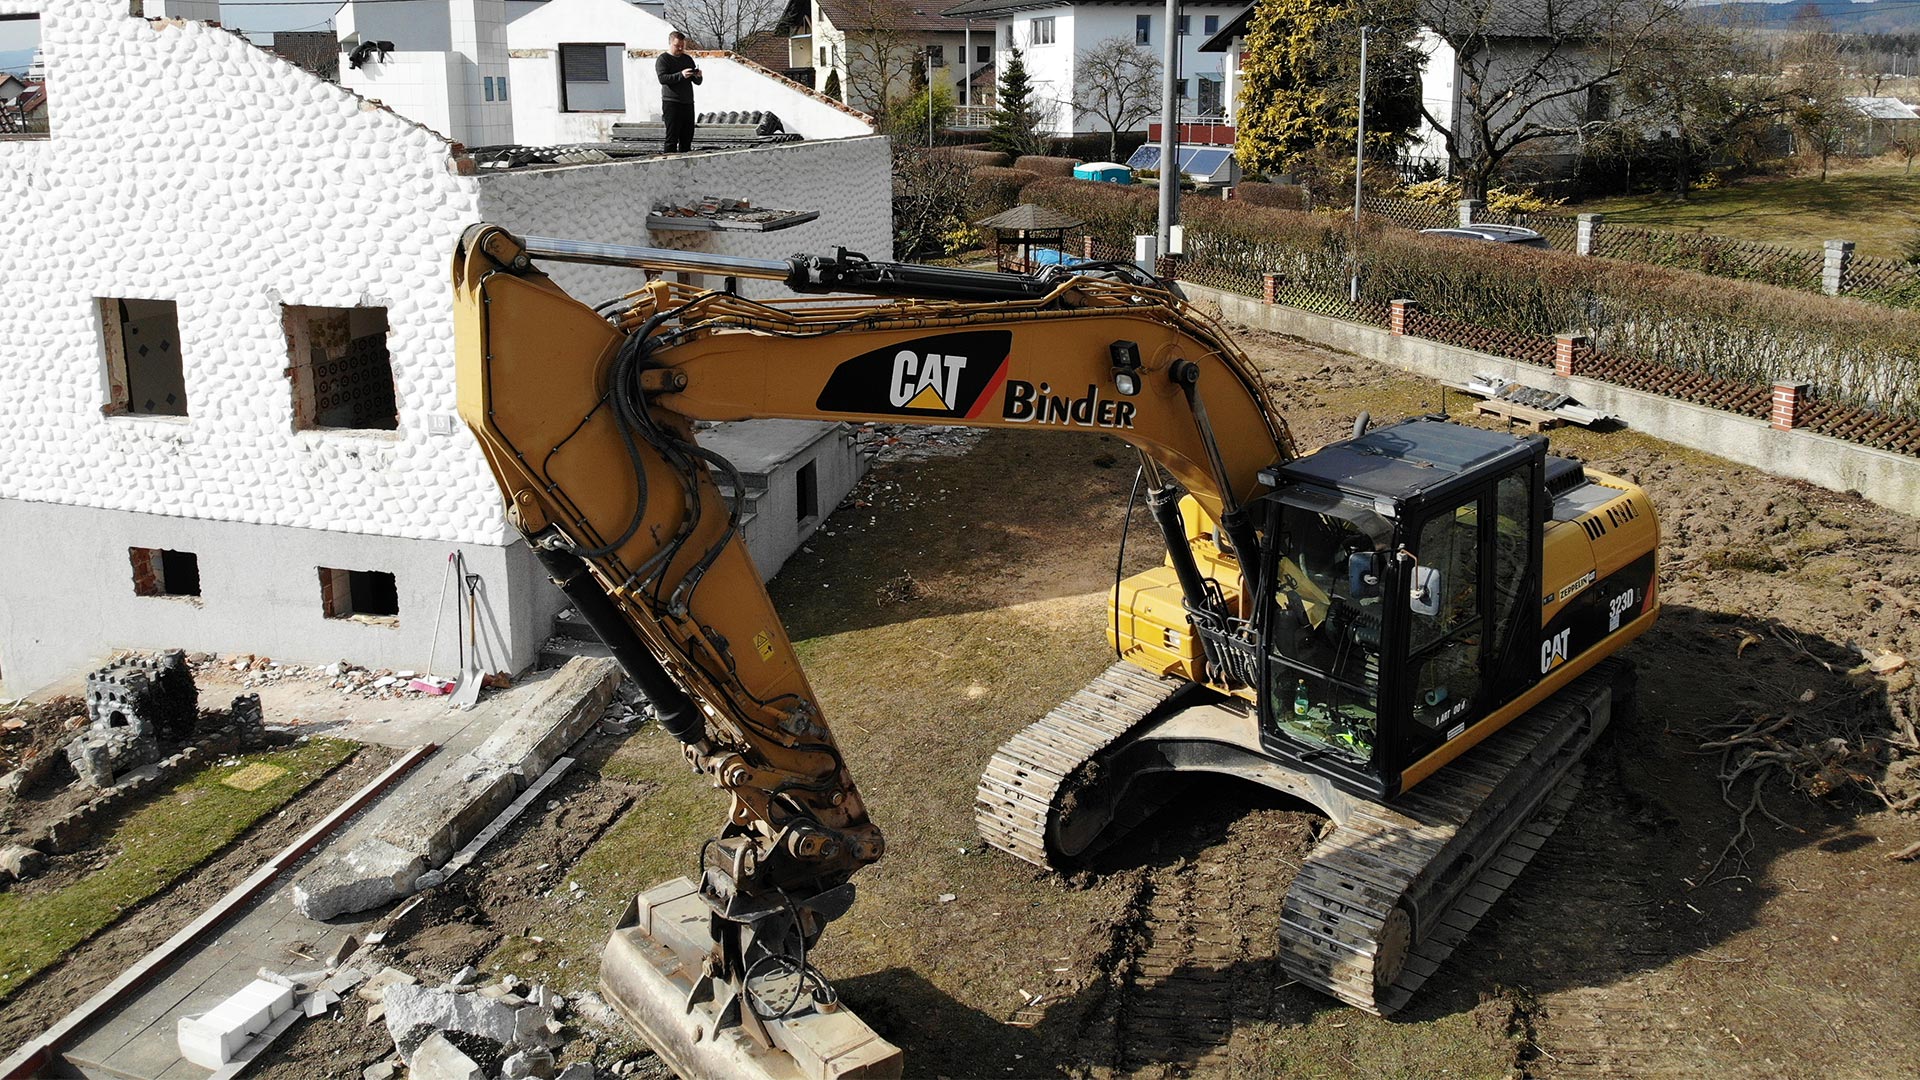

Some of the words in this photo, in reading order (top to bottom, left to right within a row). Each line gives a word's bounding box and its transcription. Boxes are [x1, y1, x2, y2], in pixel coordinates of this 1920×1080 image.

[889, 350, 967, 410] CAT
[1560, 575, 1589, 600] ZEPPELIN
[1609, 588, 1634, 618] 323D
[1541, 627, 1571, 674] CAT
